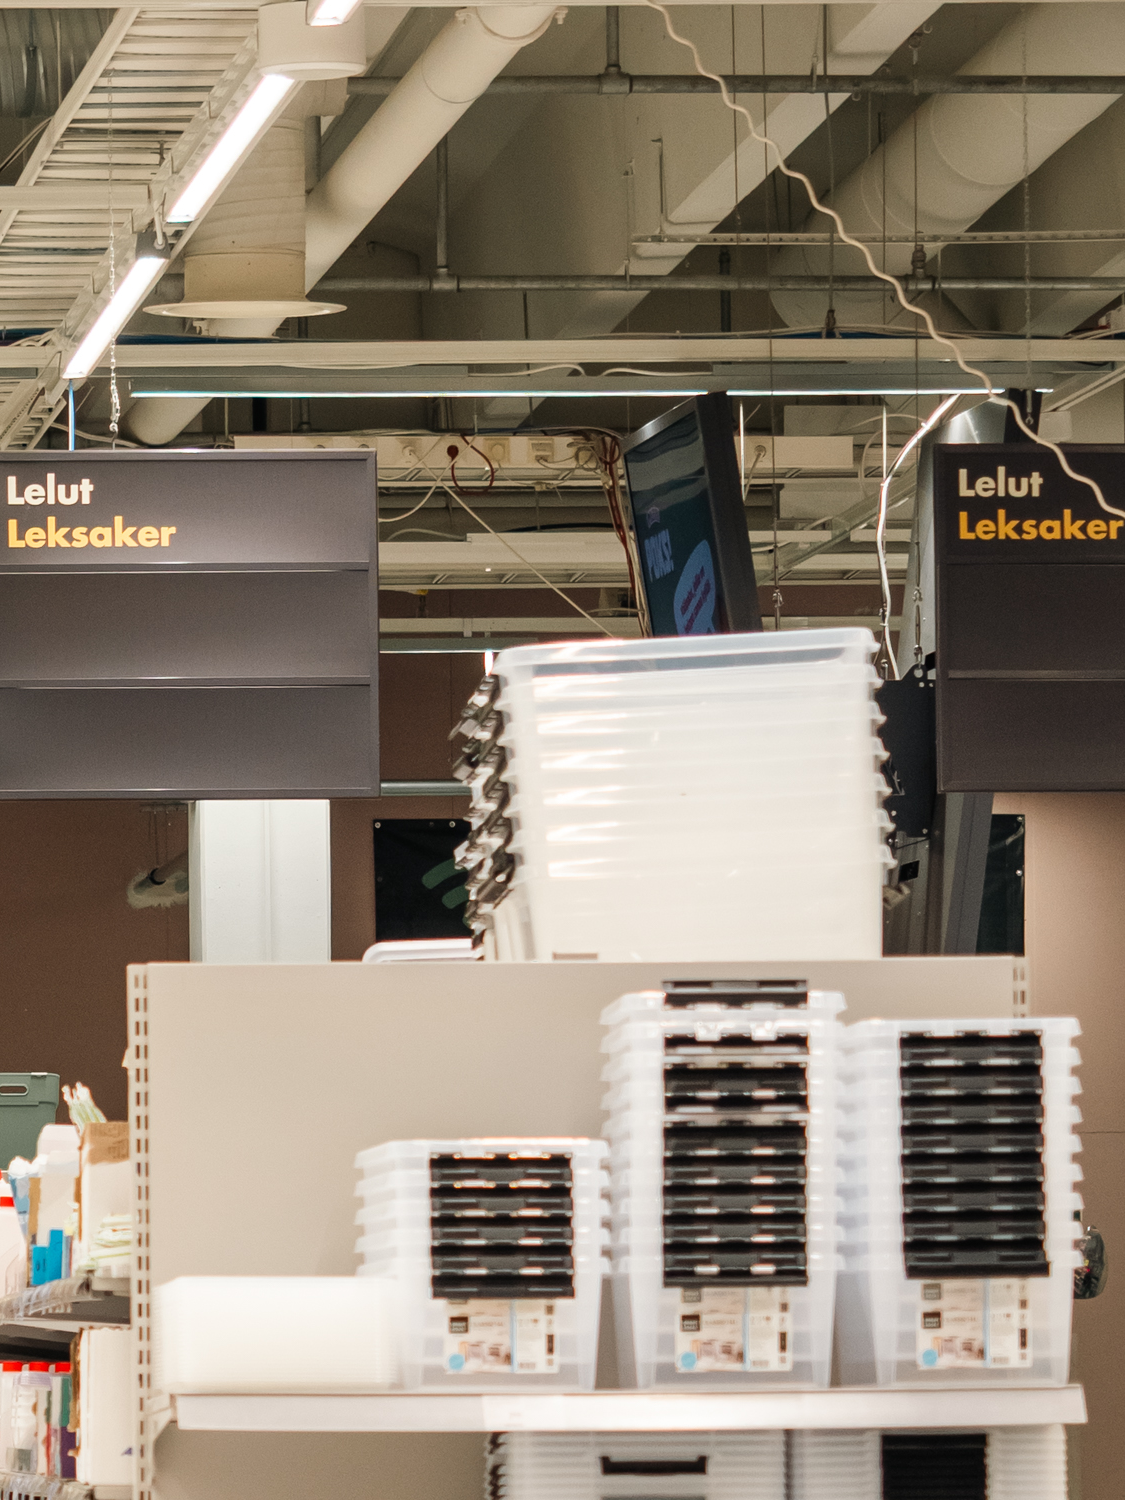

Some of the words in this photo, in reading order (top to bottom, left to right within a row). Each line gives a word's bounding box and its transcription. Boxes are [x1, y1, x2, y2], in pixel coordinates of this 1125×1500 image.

[7, 473, 94, 506] Lelut
[958, 466, 1044, 498] Lelut
[7, 515, 177, 548] Leksaker
[958, 509, 1124, 541] Leksaker
